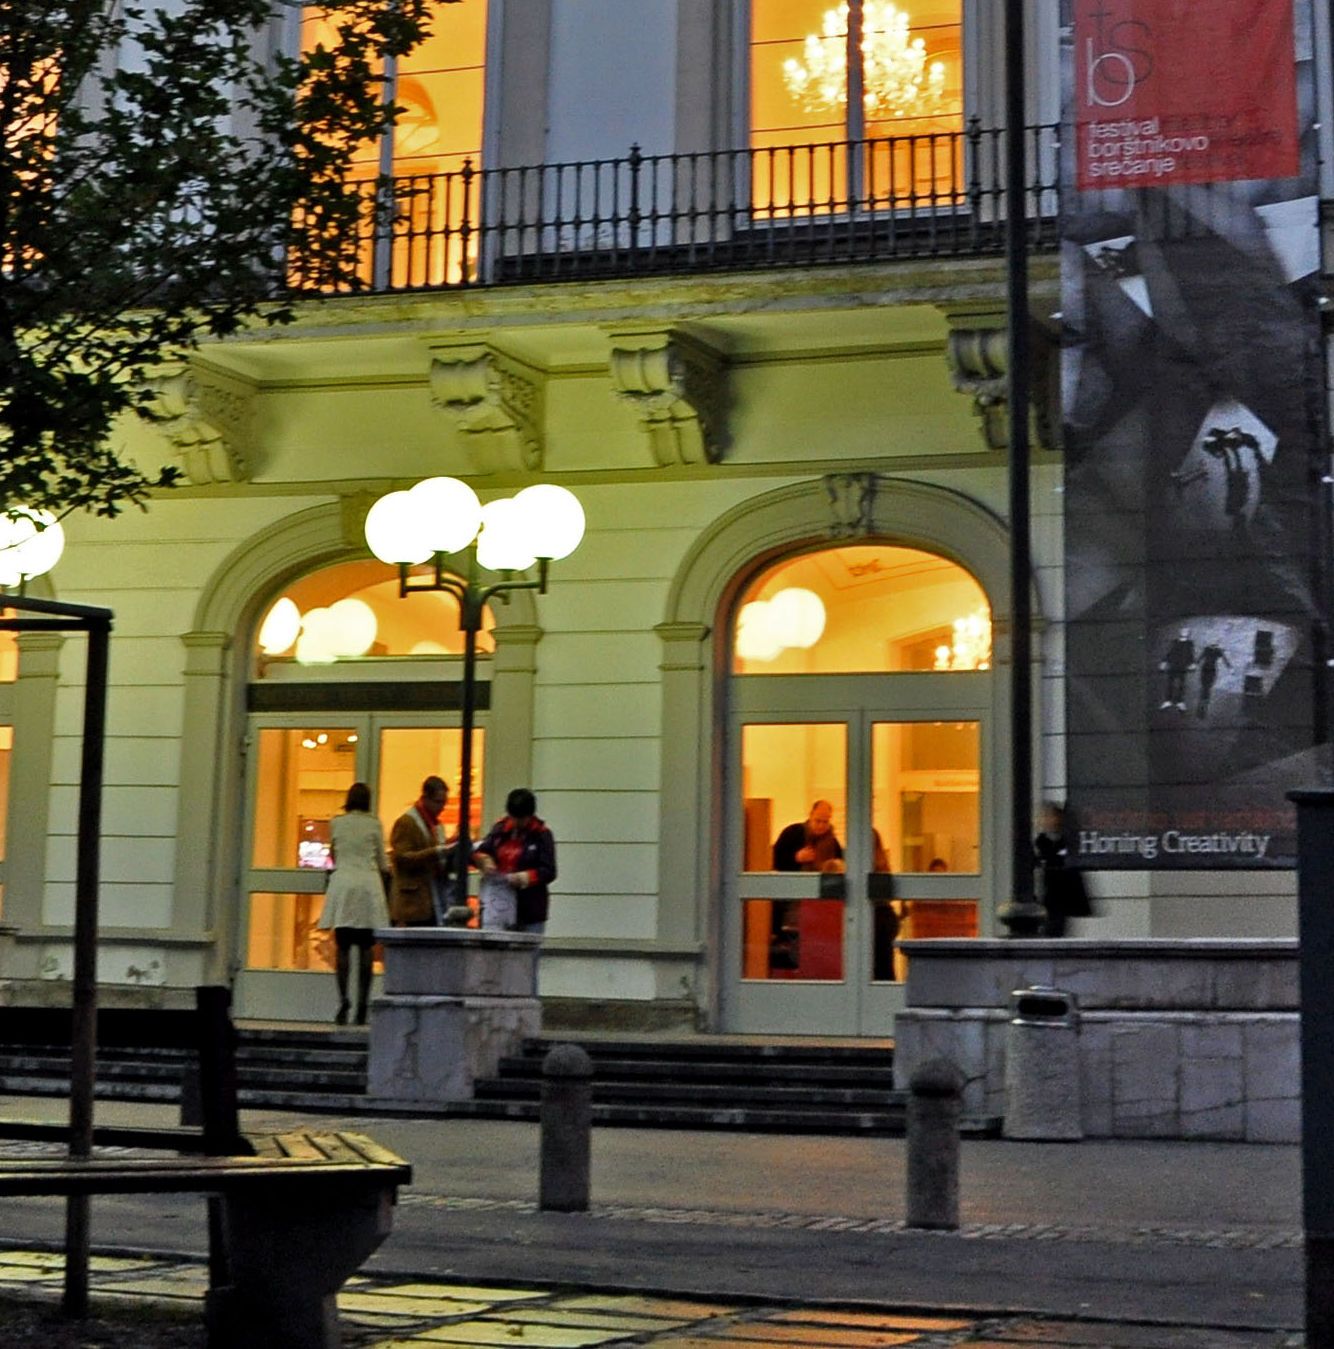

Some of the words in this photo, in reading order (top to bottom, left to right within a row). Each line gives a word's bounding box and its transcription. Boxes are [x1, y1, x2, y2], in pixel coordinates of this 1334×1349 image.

[1088, 115, 1160, 138] festival
[1078, 830, 1158, 859] Honing
[1161, 829, 1271, 858] Creativity
